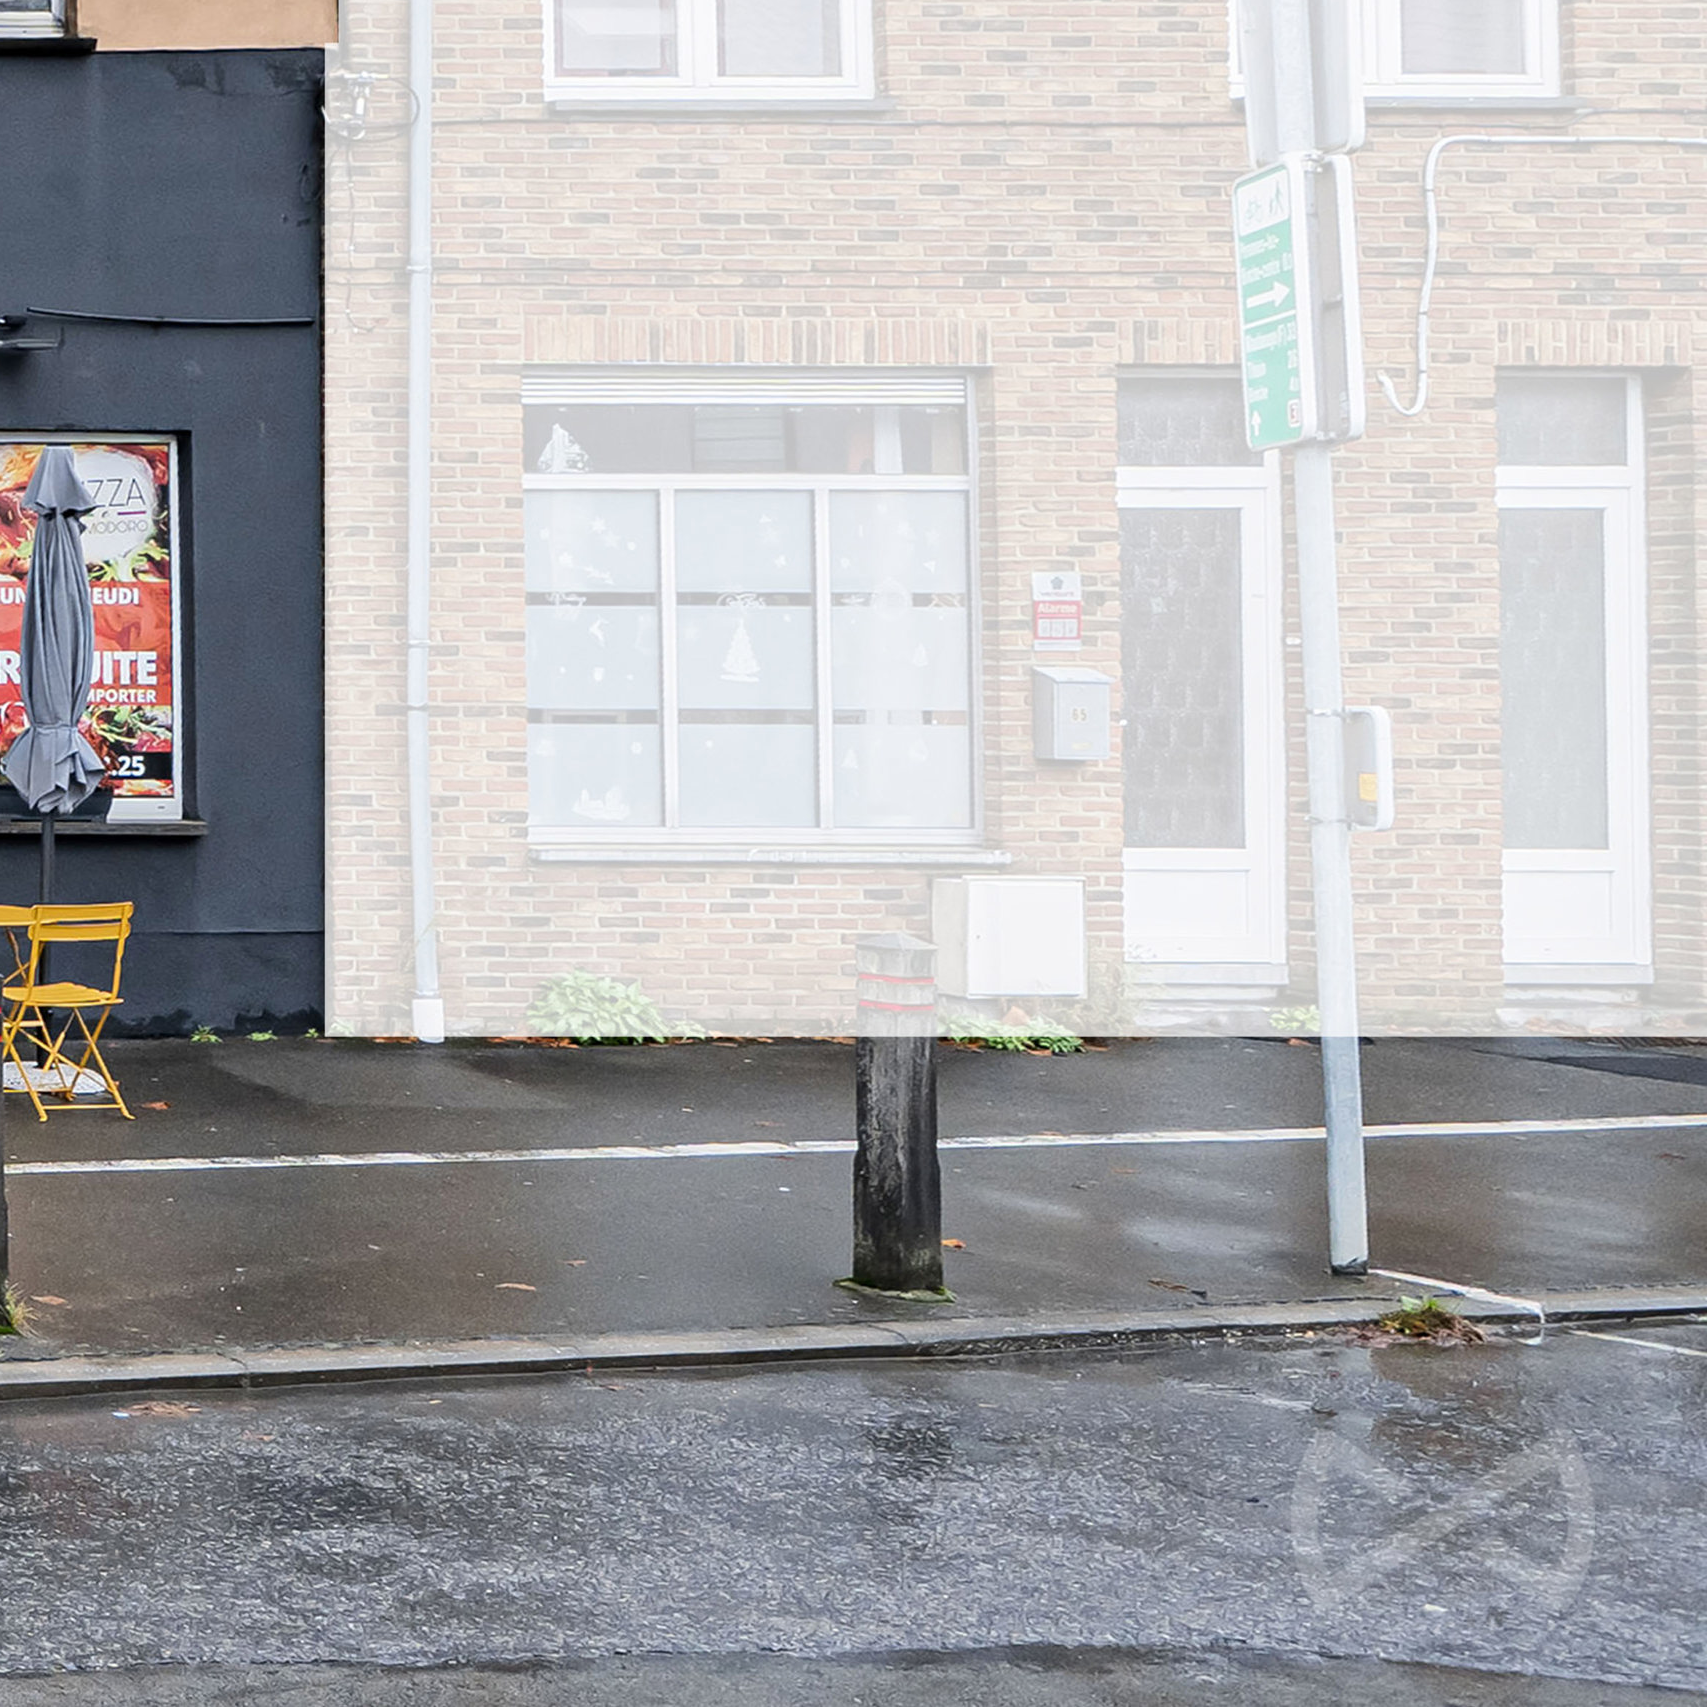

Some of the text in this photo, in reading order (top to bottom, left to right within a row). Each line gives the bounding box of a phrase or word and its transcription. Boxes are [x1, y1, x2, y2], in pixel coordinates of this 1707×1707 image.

[81, 478, 146, 507] ZZA
[88, 587, 139, 605] EUDI
[88, 689, 157, 703] MPORTER
[1072, 707, 1088, 721] 65
